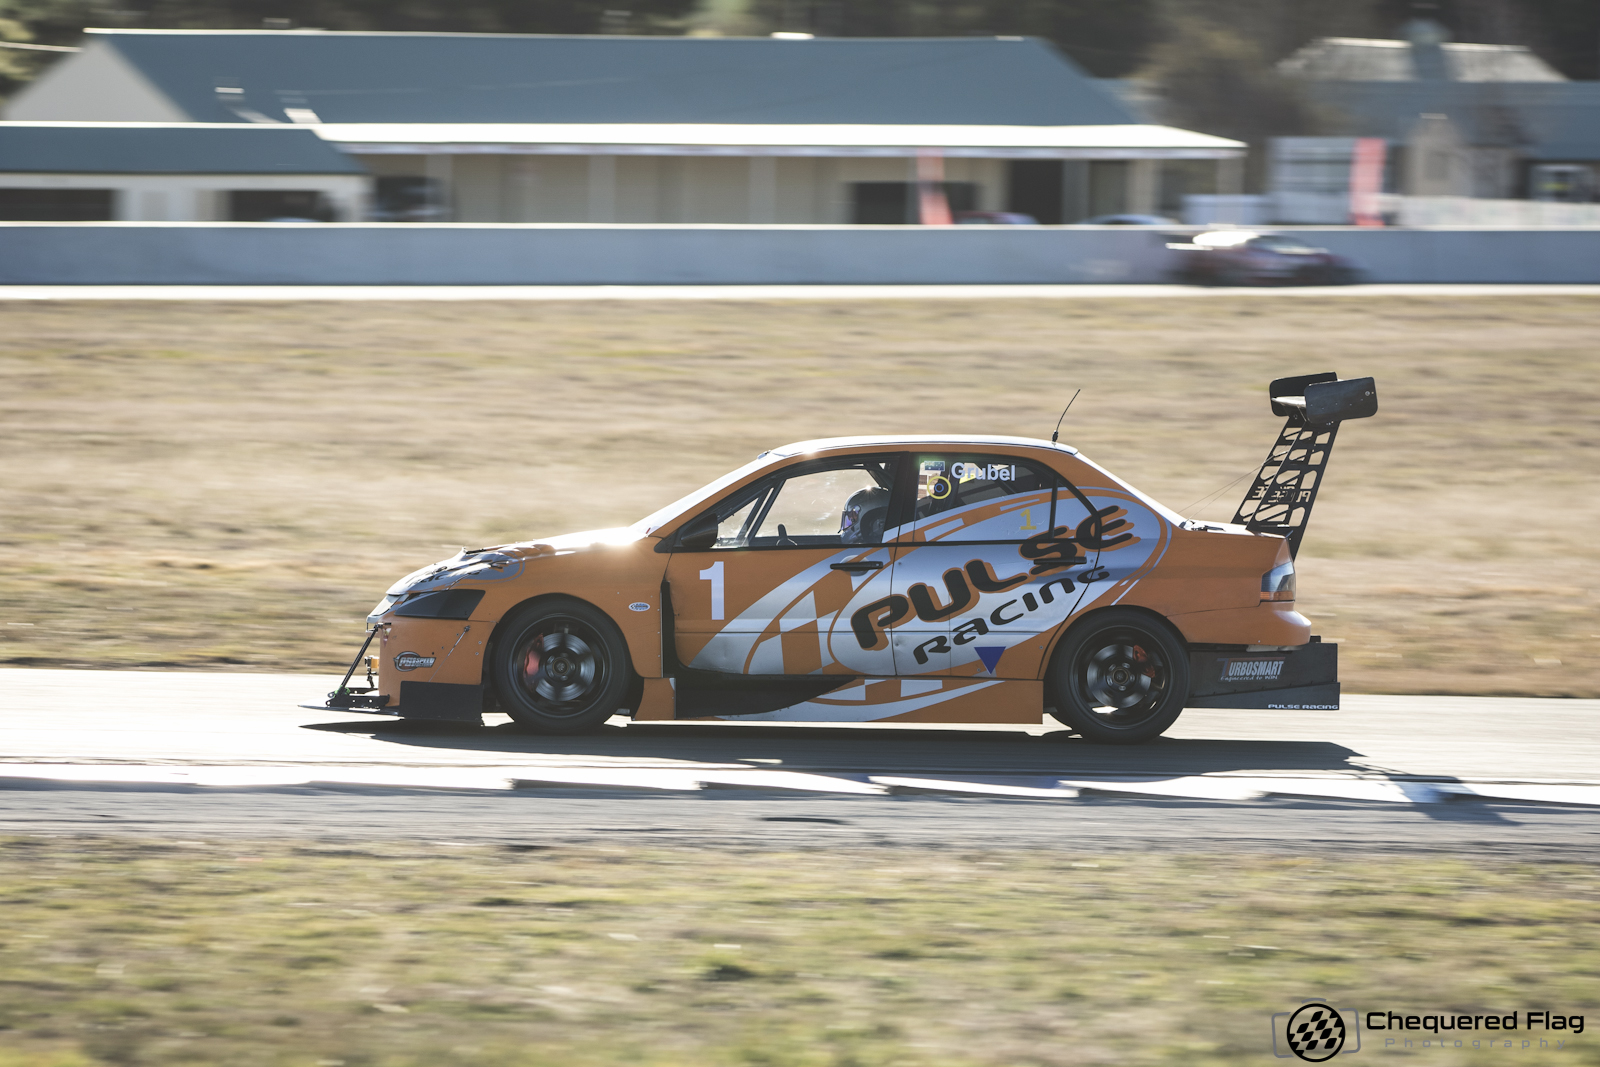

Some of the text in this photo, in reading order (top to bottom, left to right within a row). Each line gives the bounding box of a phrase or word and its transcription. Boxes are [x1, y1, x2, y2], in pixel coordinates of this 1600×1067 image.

[951, 462, 1016, 481] Grubel
[1020, 508, 1037, 530] 1
[850, 505, 1136, 651] PULSE
[699, 561, 725, 620] 1
[1217, 656, 1285, 676] TURBOSMART
